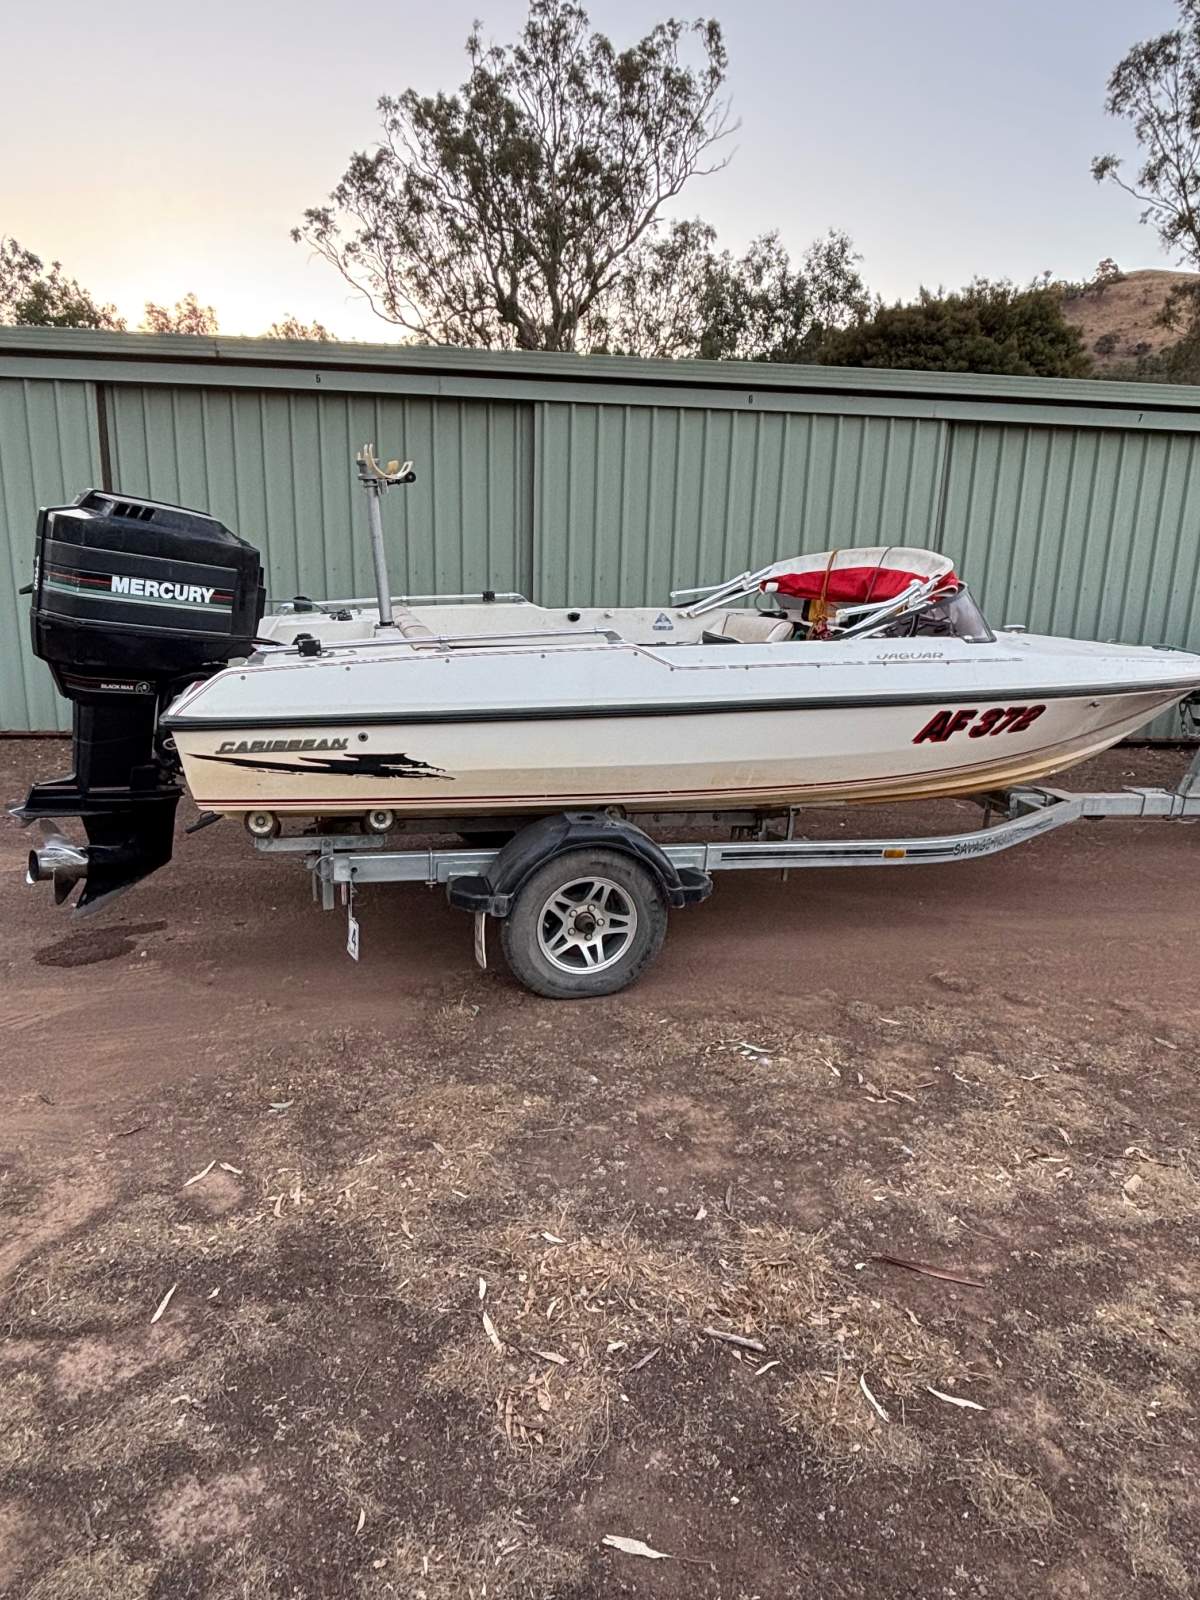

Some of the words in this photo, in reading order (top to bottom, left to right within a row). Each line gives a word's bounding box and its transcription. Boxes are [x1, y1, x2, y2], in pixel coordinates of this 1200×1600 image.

[315, 374, 321, 383] 5
[110, 575, 216, 604] MERCURY
[876, 652, 944, 660] JAGUAR
[912, 709, 979, 744] AF
[968, 704, 1047, 738] 372
[214, 738, 349, 755] CARIBBEAN
